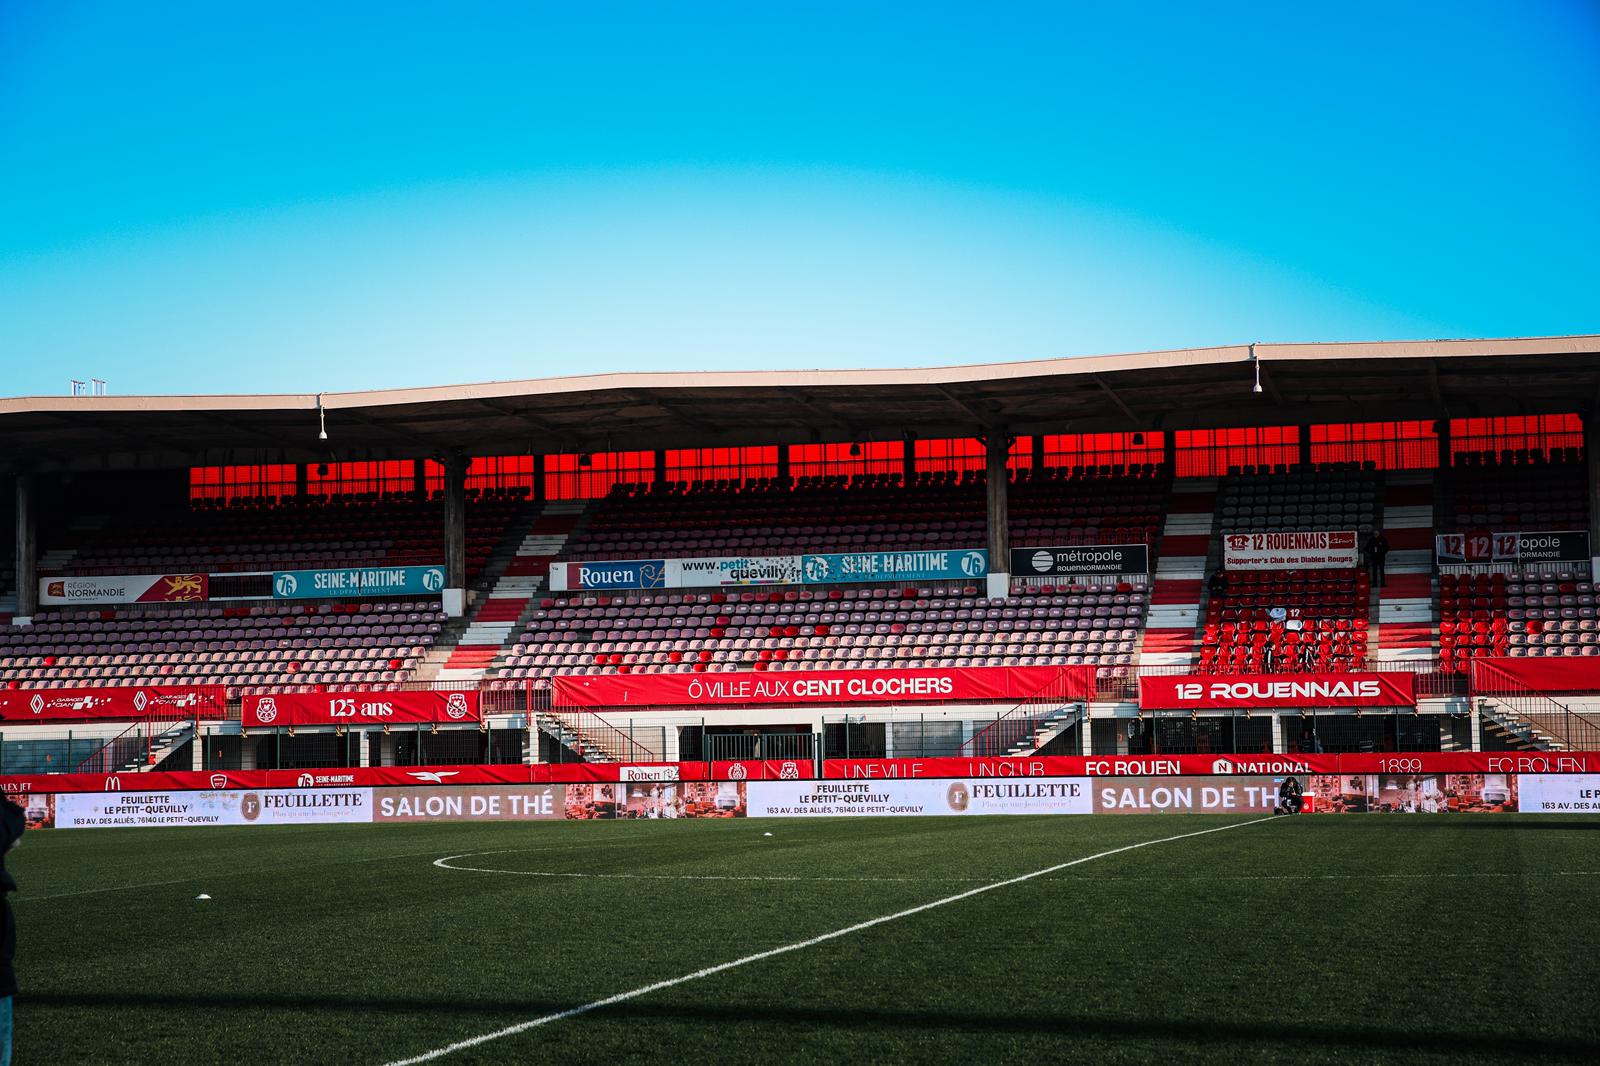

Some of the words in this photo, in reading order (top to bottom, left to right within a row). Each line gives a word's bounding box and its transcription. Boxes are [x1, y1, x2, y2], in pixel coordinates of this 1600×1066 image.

[1252, 534, 1264, 550] 12
[1266, 532, 1326, 550] ROUENNAIS
[1443, 535, 1461, 555] 12
[1470, 537, 1489, 558] 12
[1497, 536, 1516, 556] 12
[1520, 536, 1560, 551] opole
[842, 552, 948, 574] SEINE-MARITIME
[961, 552, 985, 576] 76
[1056, 549, 1122, 564] métropole
[1227, 556, 1268, 565] Supporter's
[1270, 556, 1284, 564] Club
[1300, 556, 1325, 564] Diables
[1328, 555, 1352, 564] Rouges
[314, 570, 406, 589] SEINE-MARITIME
[422, 568, 444, 591] 76
[578, 568, 635, 587] Rouen
[730, 565, 802, 582] quevilly.fr
[68, 581, 96, 589] RÉGION
[68, 588, 125, 597] NORMANDIE
[276, 574, 297, 596] 76
[1290, 608, 1300, 617] 12
[705, 681, 750, 698] VILLE
[753, 680, 790, 697] AUX
[792, 679, 844, 696] CENT
[847, 677, 953, 695] CLOCHERS
[1174, 682, 1202, 700] 12
[1210, 680, 1381, 699] ROUENNAIS
[330, 699, 355, 717] 125
[360, 700, 393, 716] ans
[1085, 761, 1110, 775] FC
[1114, 760, 1180, 775] ROUEN
[1237, 762, 1312, 773] NATIONAL
[1379, 758, 1422, 772] 1899
[1488, 757, 1514, 772] FC
[1518, 757, 1586, 772] ROUEN
[316, 775, 354, 783] SEINE-MARITIME
[627, 769, 660, 780] Rouen
[19, 782, 32, 792] JET
[816, 784, 869, 793] FEUILLETTE
[972, 784, 1080, 798] FEUILLETTE
[1580, 790, 1592, 798] LE
[121, 796, 170, 804] FEUILLETTE
[264, 793, 362, 808] FEUILLETTE
[380, 796, 463, 817] SALON
[471, 796, 500, 816] DE
[508, 786, 554, 815] THÉ
[800, 795, 809, 804] LE
[811, 794, 890, 804] PETIT-QUEVILLY
[1101, 787, 1192, 808] SALON
[1202, 787, 1236, 808] DE
[1244, 787, 1280, 808] TH
[104, 806, 114, 814] LE
[116, 805, 188, 814] PETIT-QUEVILLY
[247, 802, 256, 813] F
[809, 805, 834, 815] ALLIÉS,
[113, 816, 136, 824] ALLIÉS,
